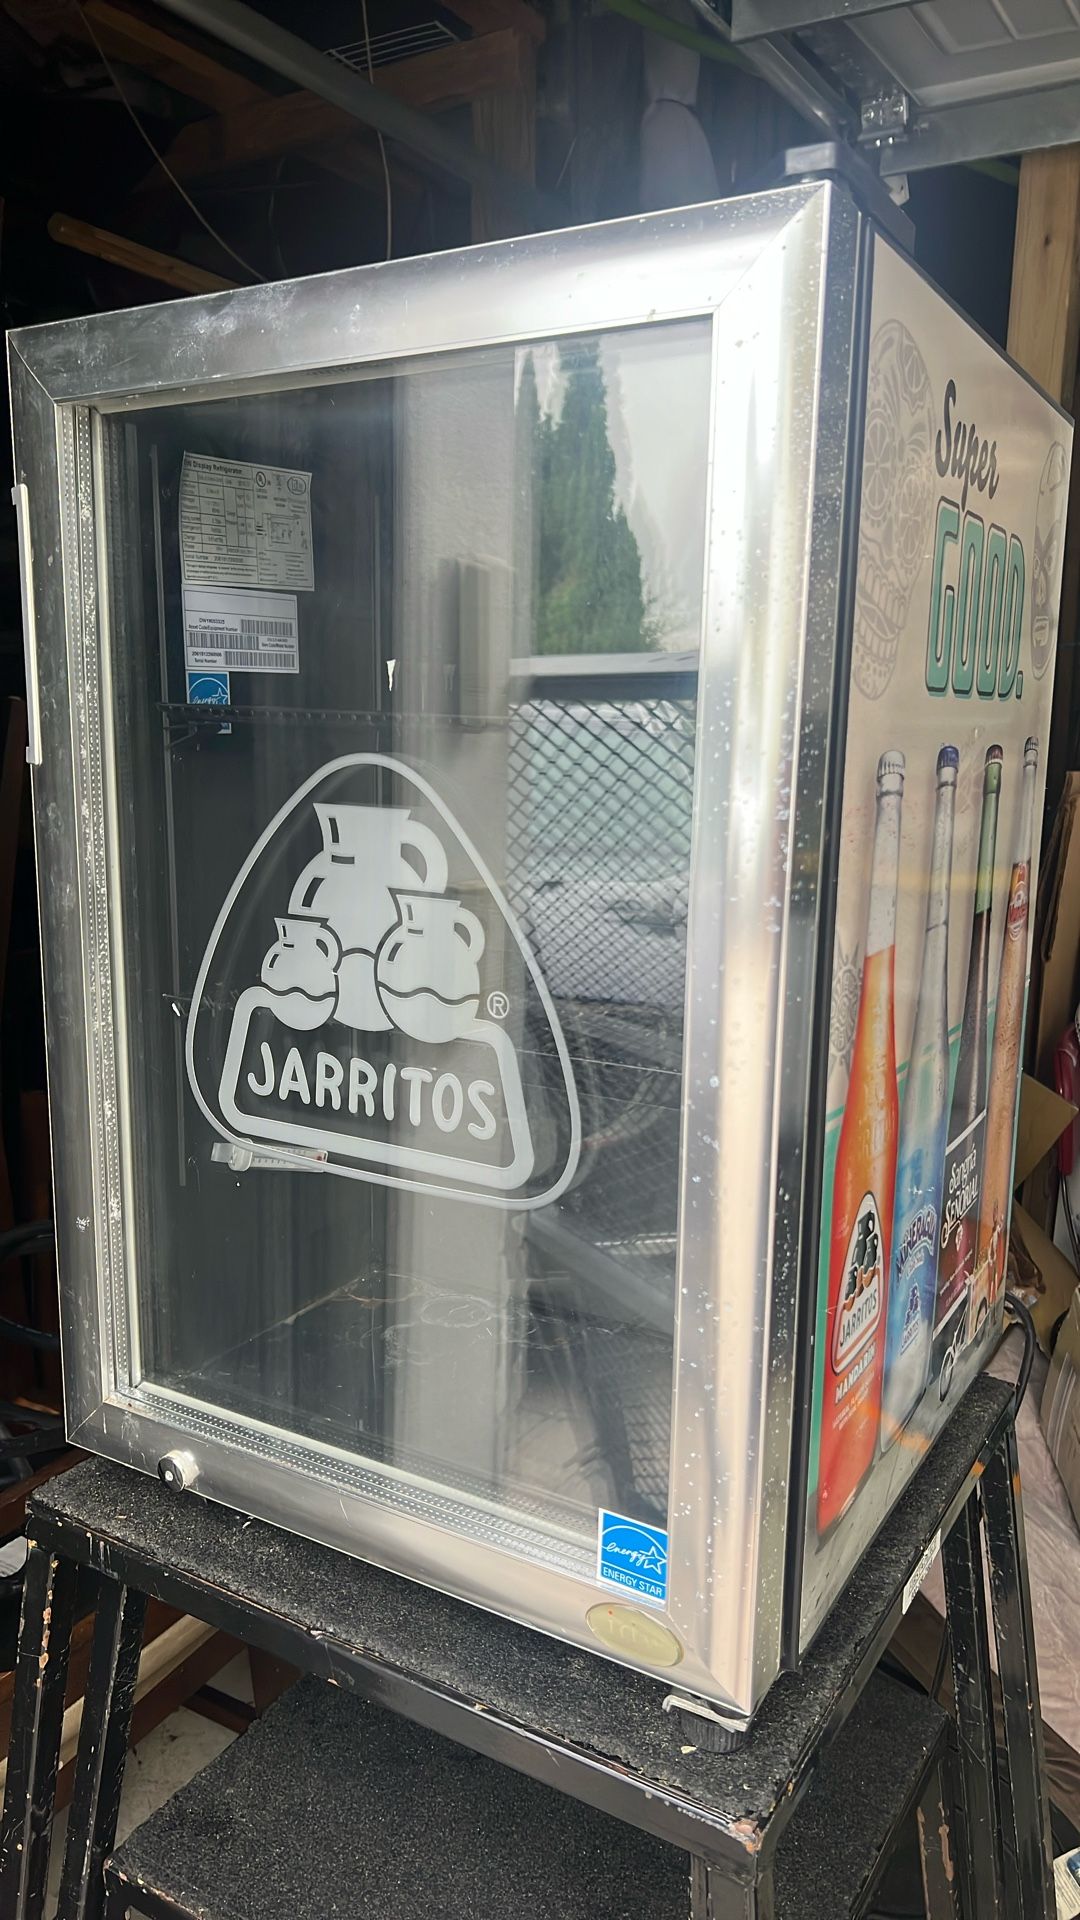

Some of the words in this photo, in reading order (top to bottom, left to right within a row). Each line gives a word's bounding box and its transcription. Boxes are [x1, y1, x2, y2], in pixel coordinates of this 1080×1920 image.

[935, 379, 999, 512] Super
[926, 496, 1026, 701] GOOD.
[247, 1041, 497, 1141] JARRITOS
[840, 1287, 878, 1347] JARRITOS
[602, 1542, 648, 1567] energy
[602, 1566, 638, 1587] ENERGY
[638, 1580, 663, 1596] STAR
